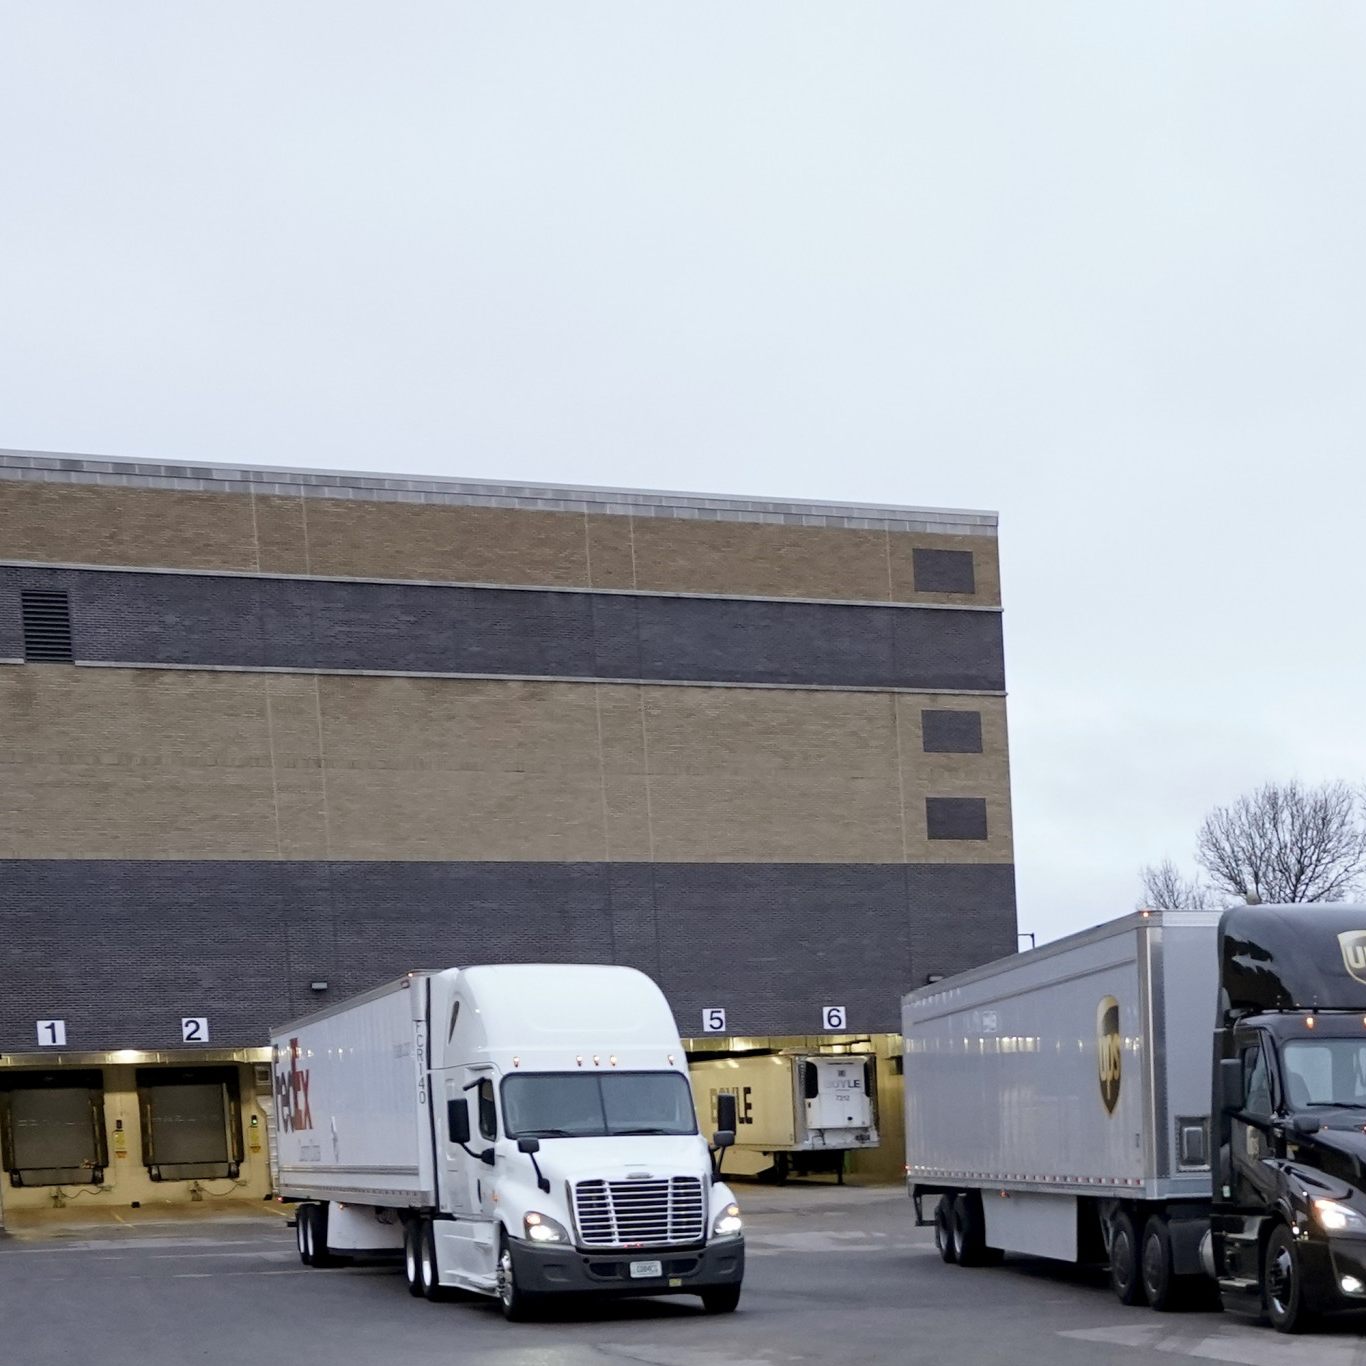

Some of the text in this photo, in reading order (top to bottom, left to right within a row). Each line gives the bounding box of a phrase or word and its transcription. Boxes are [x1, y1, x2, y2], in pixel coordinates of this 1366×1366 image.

[709, 1010, 724, 1030] 5
[827, 1008, 842, 1028] 6
[44, 1022, 57, 1044] 1
[184, 1020, 202, 1041] 2
[1099, 1033, 1121, 1100] ups
[273, 1037, 314, 1134] FedEx
[710, 1086, 753, 1124] BLE
